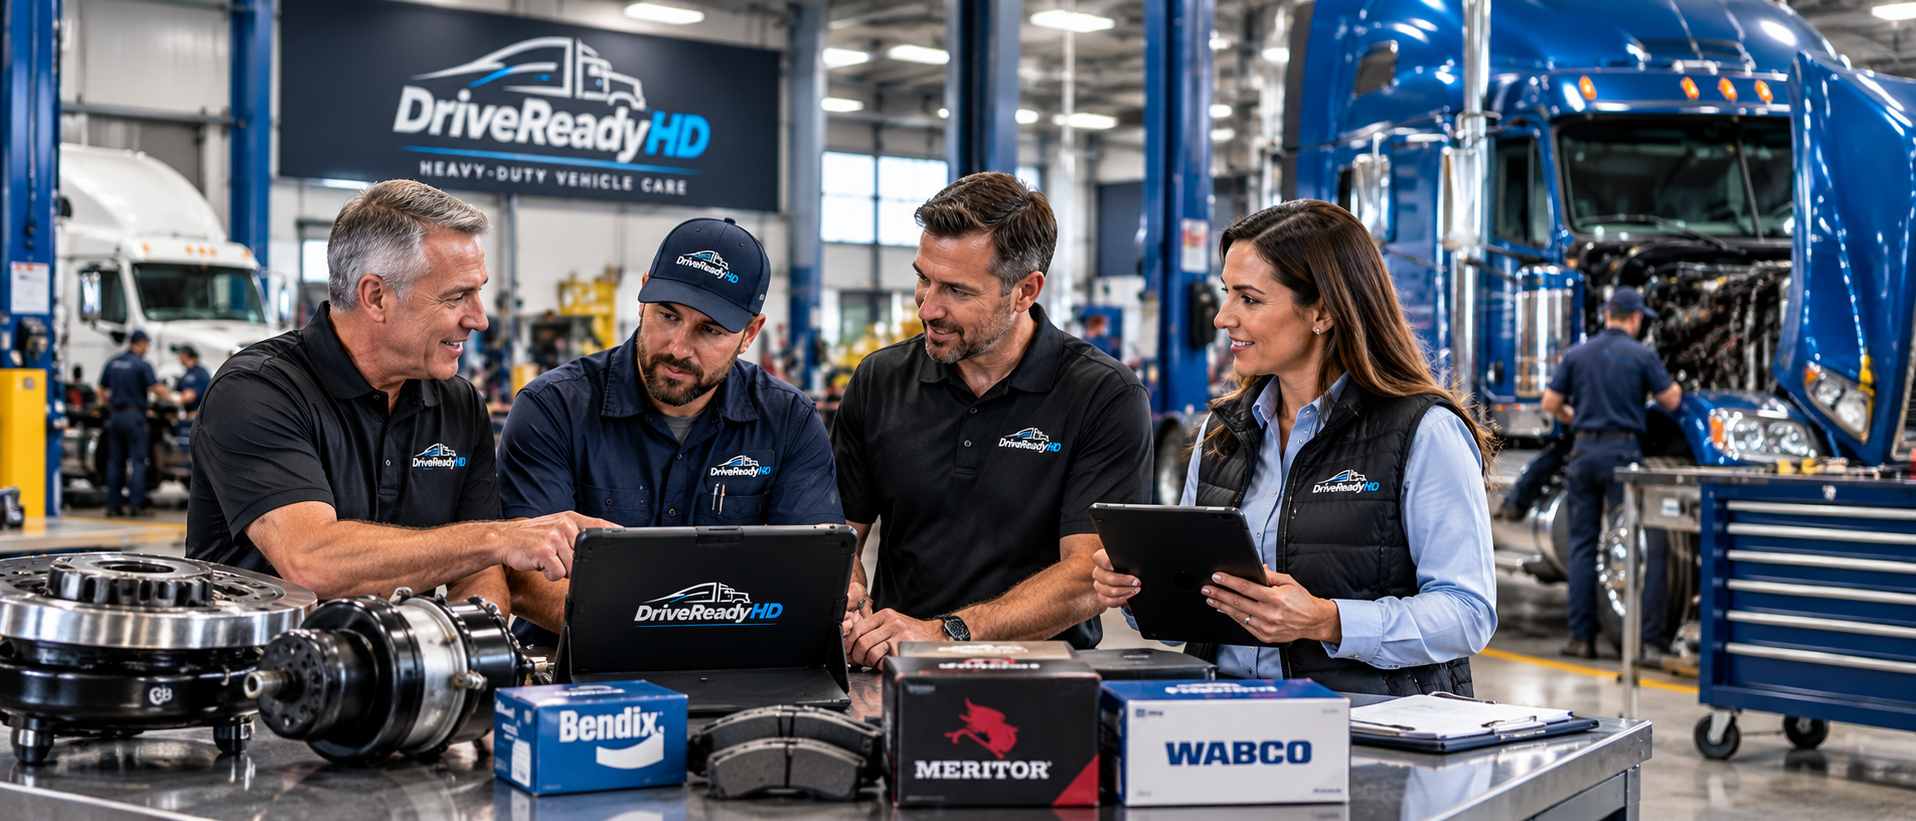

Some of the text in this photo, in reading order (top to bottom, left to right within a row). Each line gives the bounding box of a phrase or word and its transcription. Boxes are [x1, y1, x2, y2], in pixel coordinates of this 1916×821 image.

[420, 160, 687, 195] HEAVY-DUTY VEHICLE CARE
[1165, 740, 1313, 766] WABCO
[914, 760, 1051, 780] MERITOR
